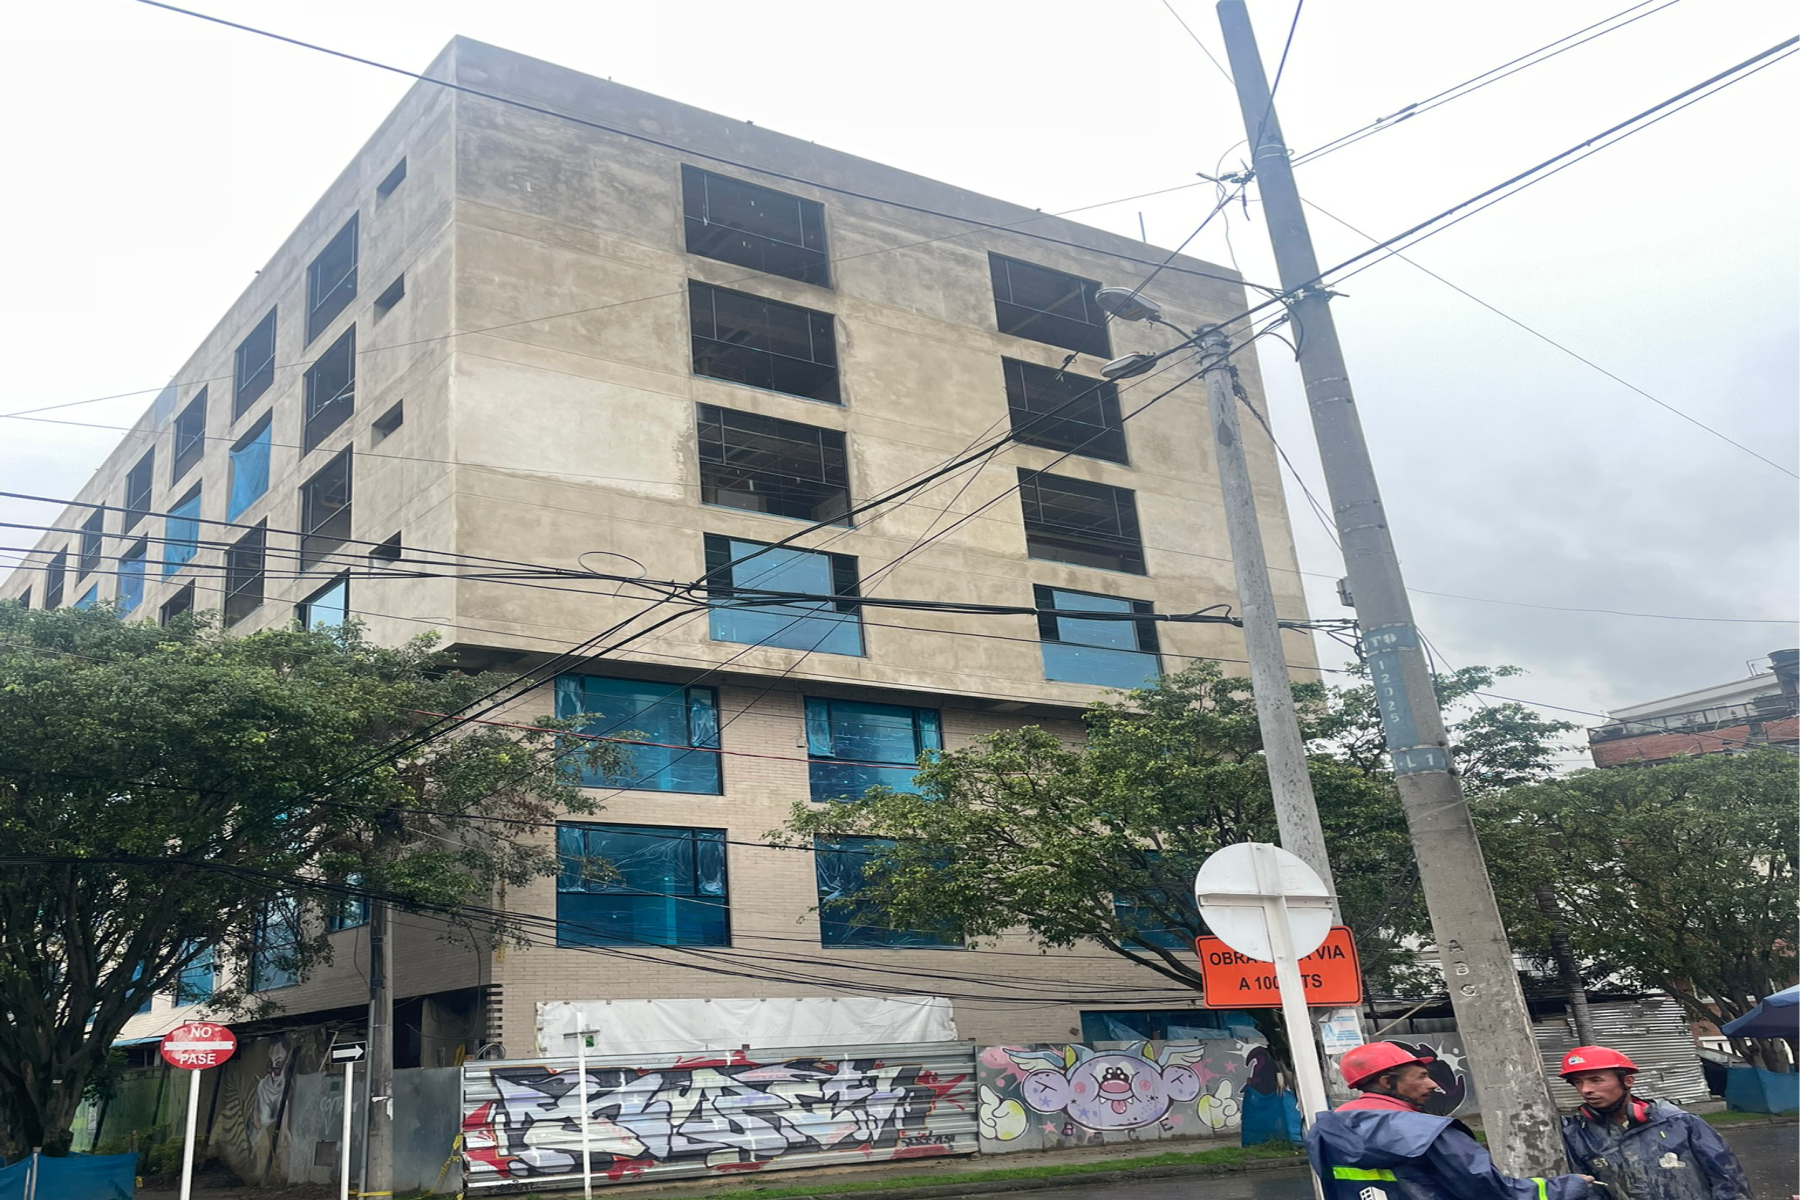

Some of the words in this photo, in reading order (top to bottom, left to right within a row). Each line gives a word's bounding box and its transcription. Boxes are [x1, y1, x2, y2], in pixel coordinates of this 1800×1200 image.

[1316, 944, 1346, 960] VIA
[1238, 977, 1251, 991] A
[1300, 973, 1323, 989] TS
[190, 1027, 212, 1038] NO
[179, 1053, 216, 1065] PASE
